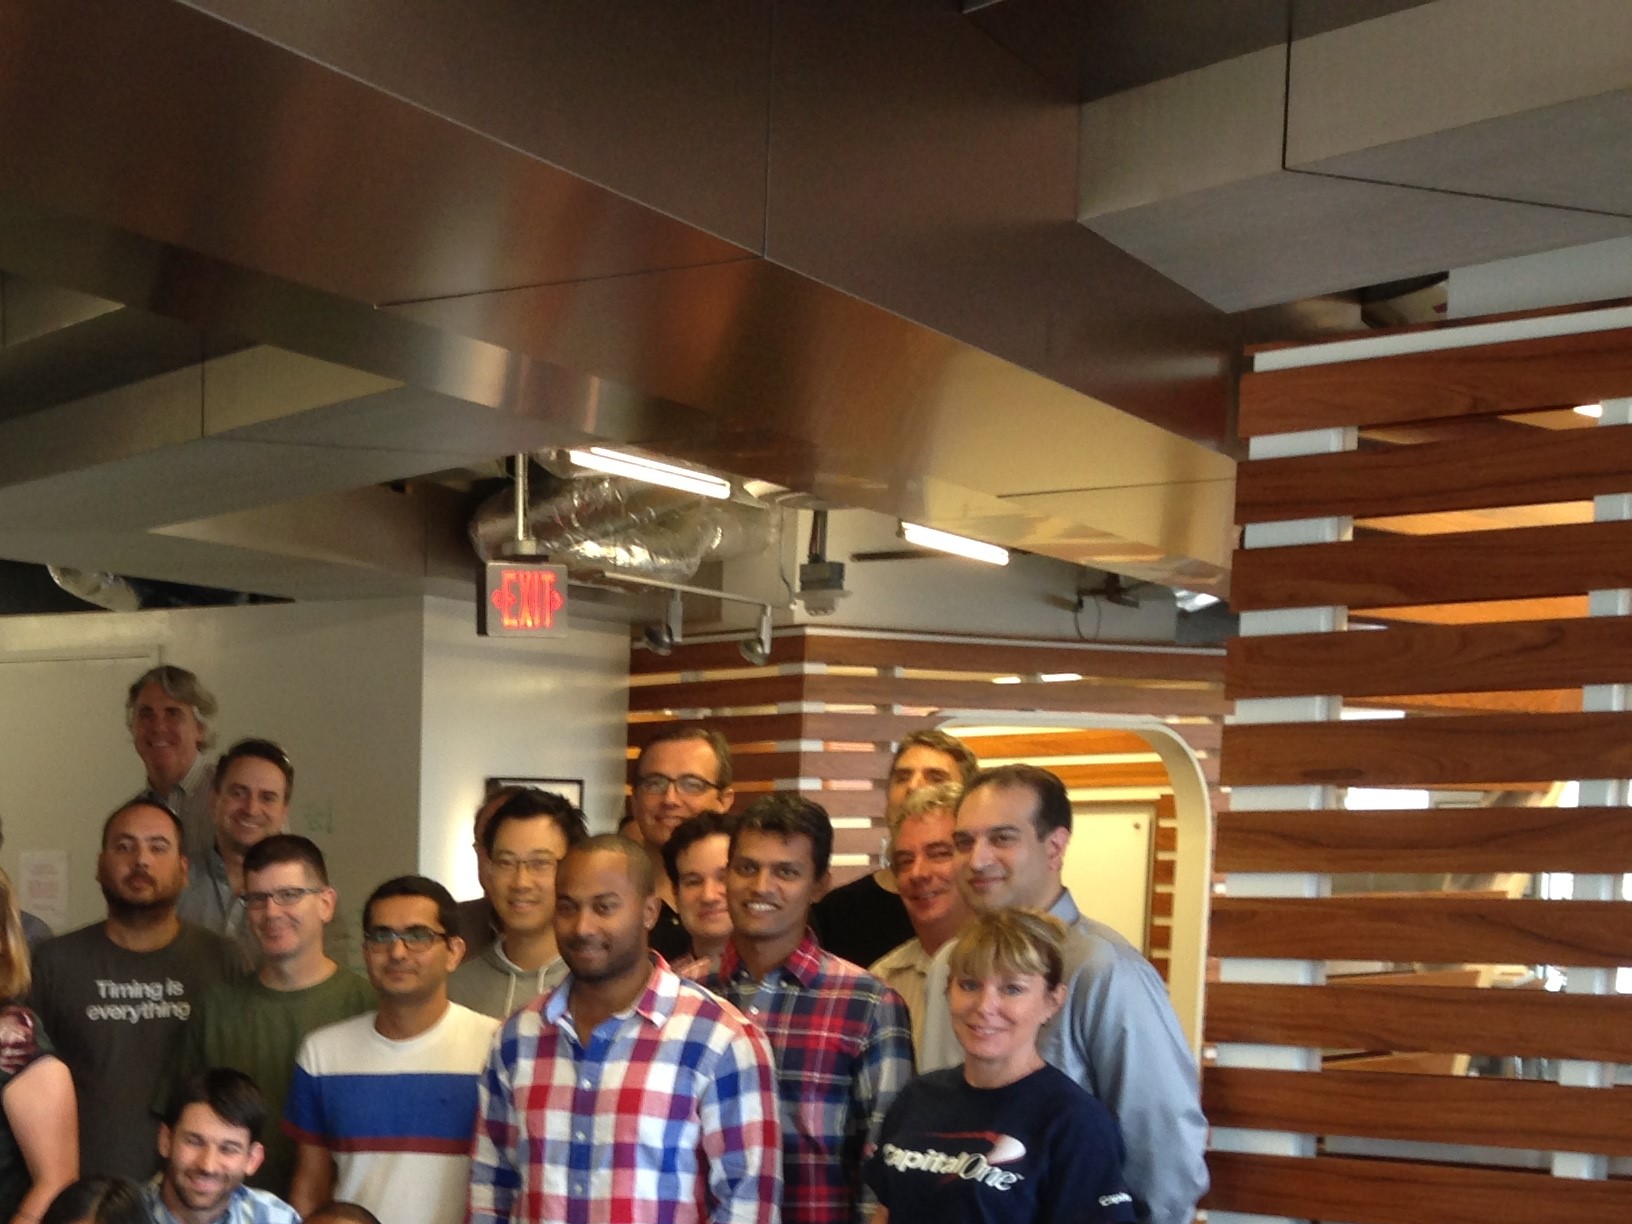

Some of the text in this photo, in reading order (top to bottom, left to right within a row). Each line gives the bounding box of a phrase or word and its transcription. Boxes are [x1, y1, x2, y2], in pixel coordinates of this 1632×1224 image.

[502, 571, 555, 628] EXIT
[95, 978, 184, 1001] Timing is
[86, 1000, 190, 1024] everything
